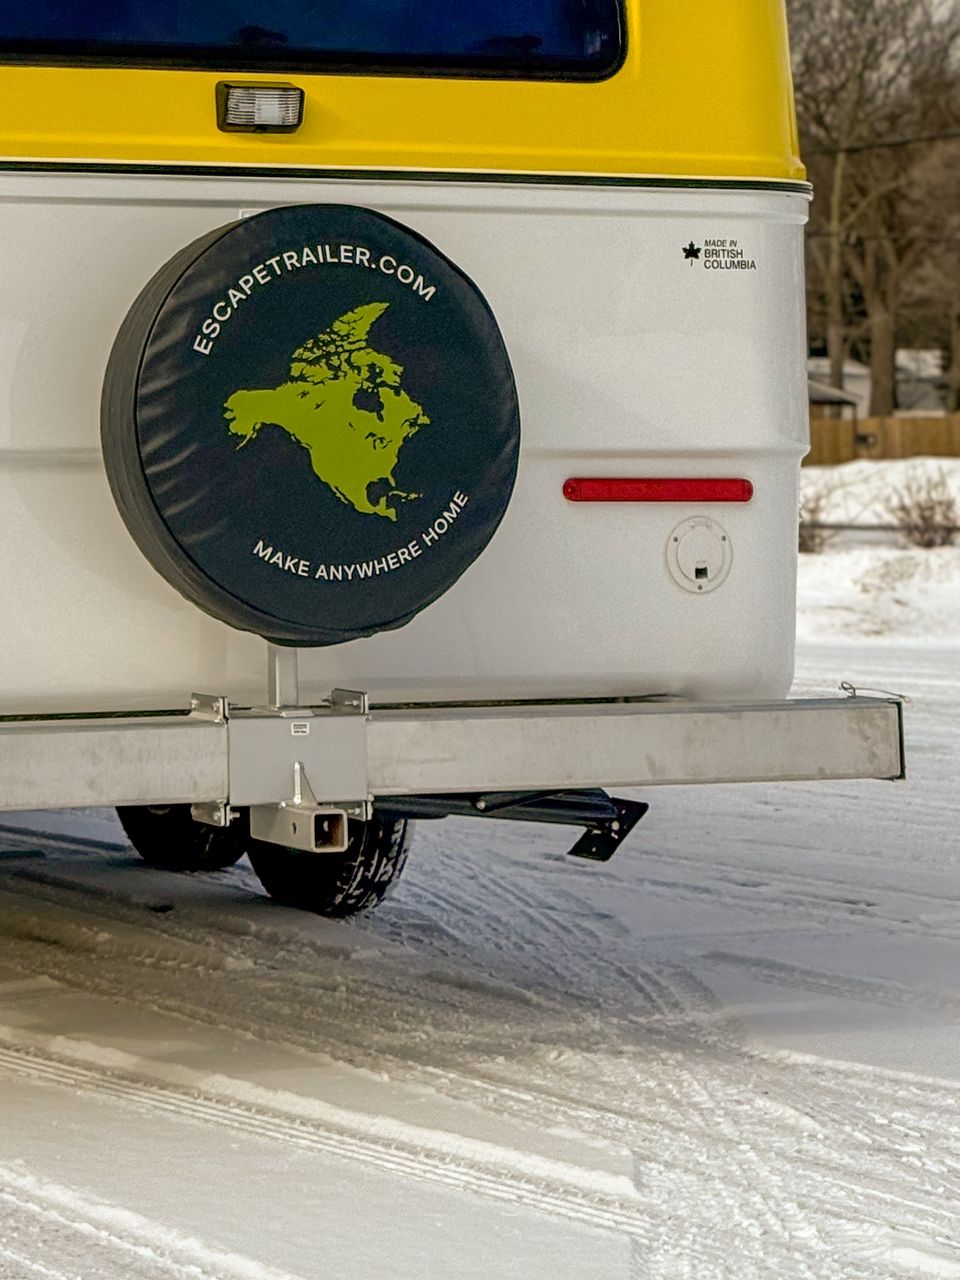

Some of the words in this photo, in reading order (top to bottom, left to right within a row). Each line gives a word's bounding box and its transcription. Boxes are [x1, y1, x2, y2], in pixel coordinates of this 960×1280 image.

[704, 239, 727, 248] MADE
[729, 239, 738, 248] IN
[704, 248, 744, 259] BRITISH
[703, 259, 757, 270] COLUMBIA
[193, 244, 437, 356] ESCAPETRAILER.COM
[252, 540, 311, 577] MAKE
[315, 542, 424, 581] ANYWHERE
[422, 490, 469, 547] HOME
